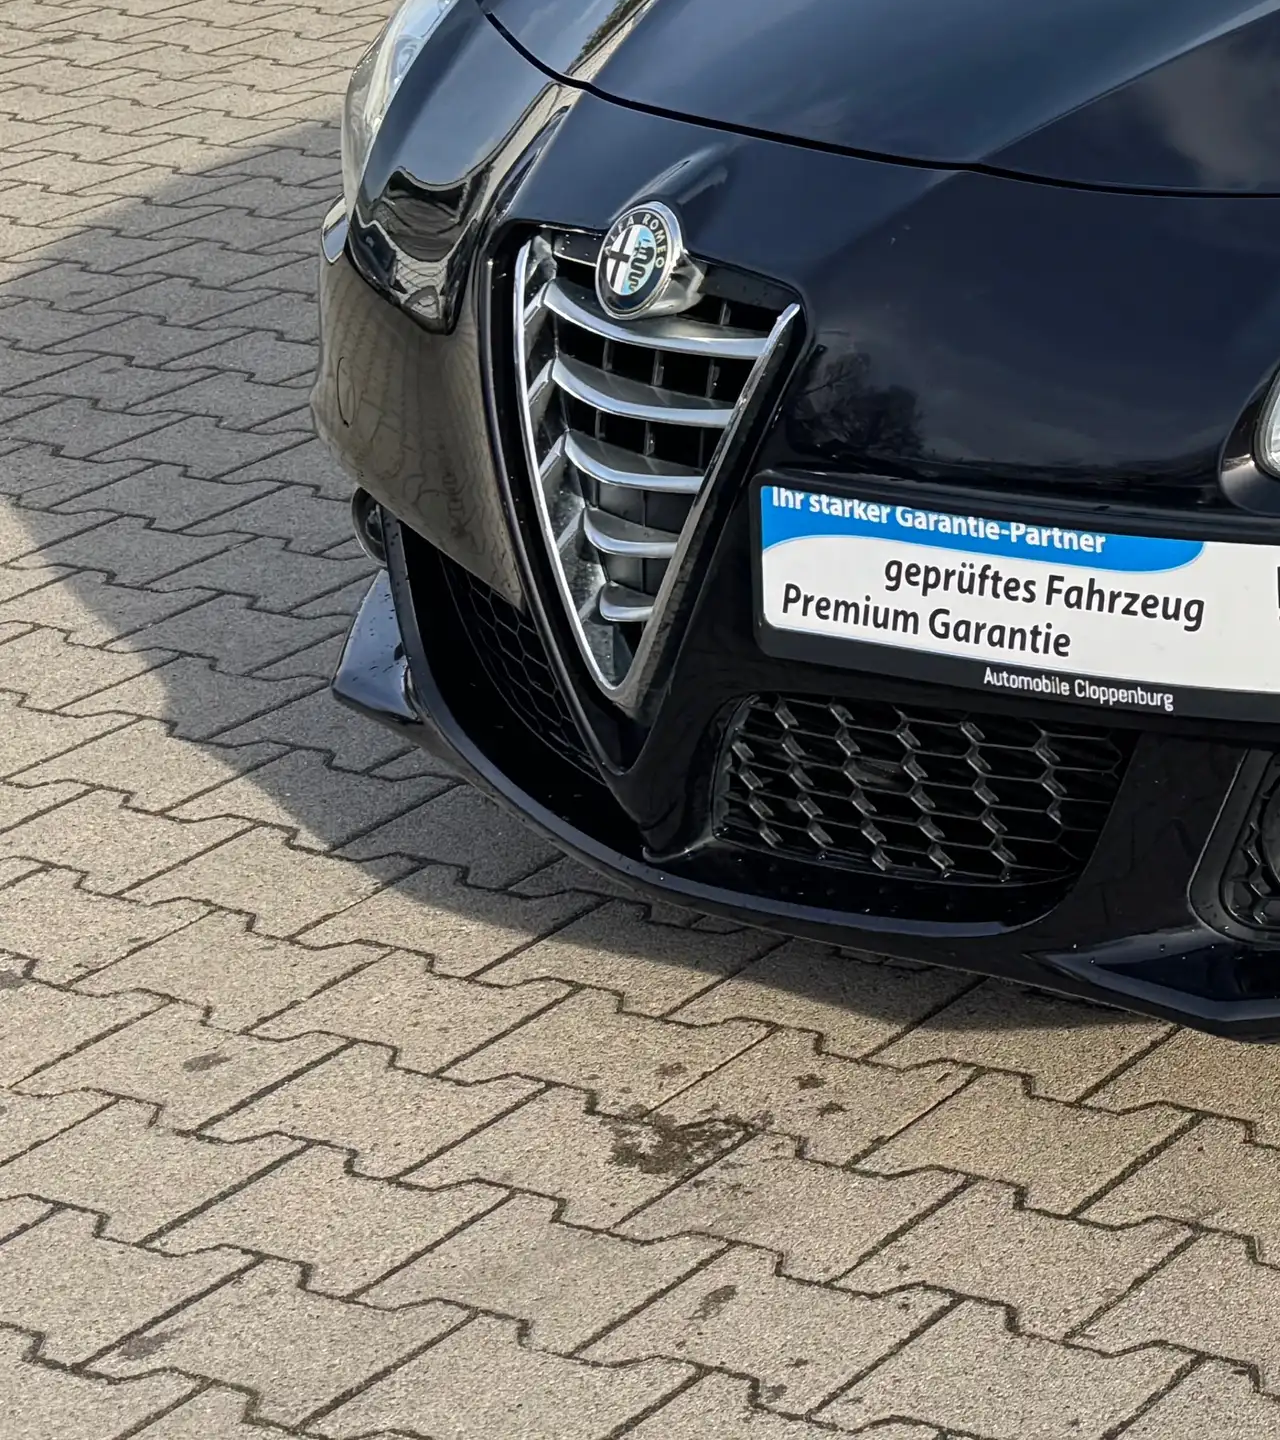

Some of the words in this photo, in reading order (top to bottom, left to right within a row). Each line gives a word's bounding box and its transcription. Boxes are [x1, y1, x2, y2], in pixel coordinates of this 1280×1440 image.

[642, 213, 667, 269] ROMEO
[772, 486, 804, 510] Ihr
[809, 493, 891, 525] starker
[894, 505, 1106, 554] Garantie-Partner
[782, 583, 920, 636] Premium
[929, 608, 1072, 658] Garantie
[884, 559, 1037, 604] geprüftes
[1044, 574, 1205, 633] Fahrzeug
[983, 666, 1070, 697] Automobile
[1073, 678, 1175, 713] Cloppenburg
